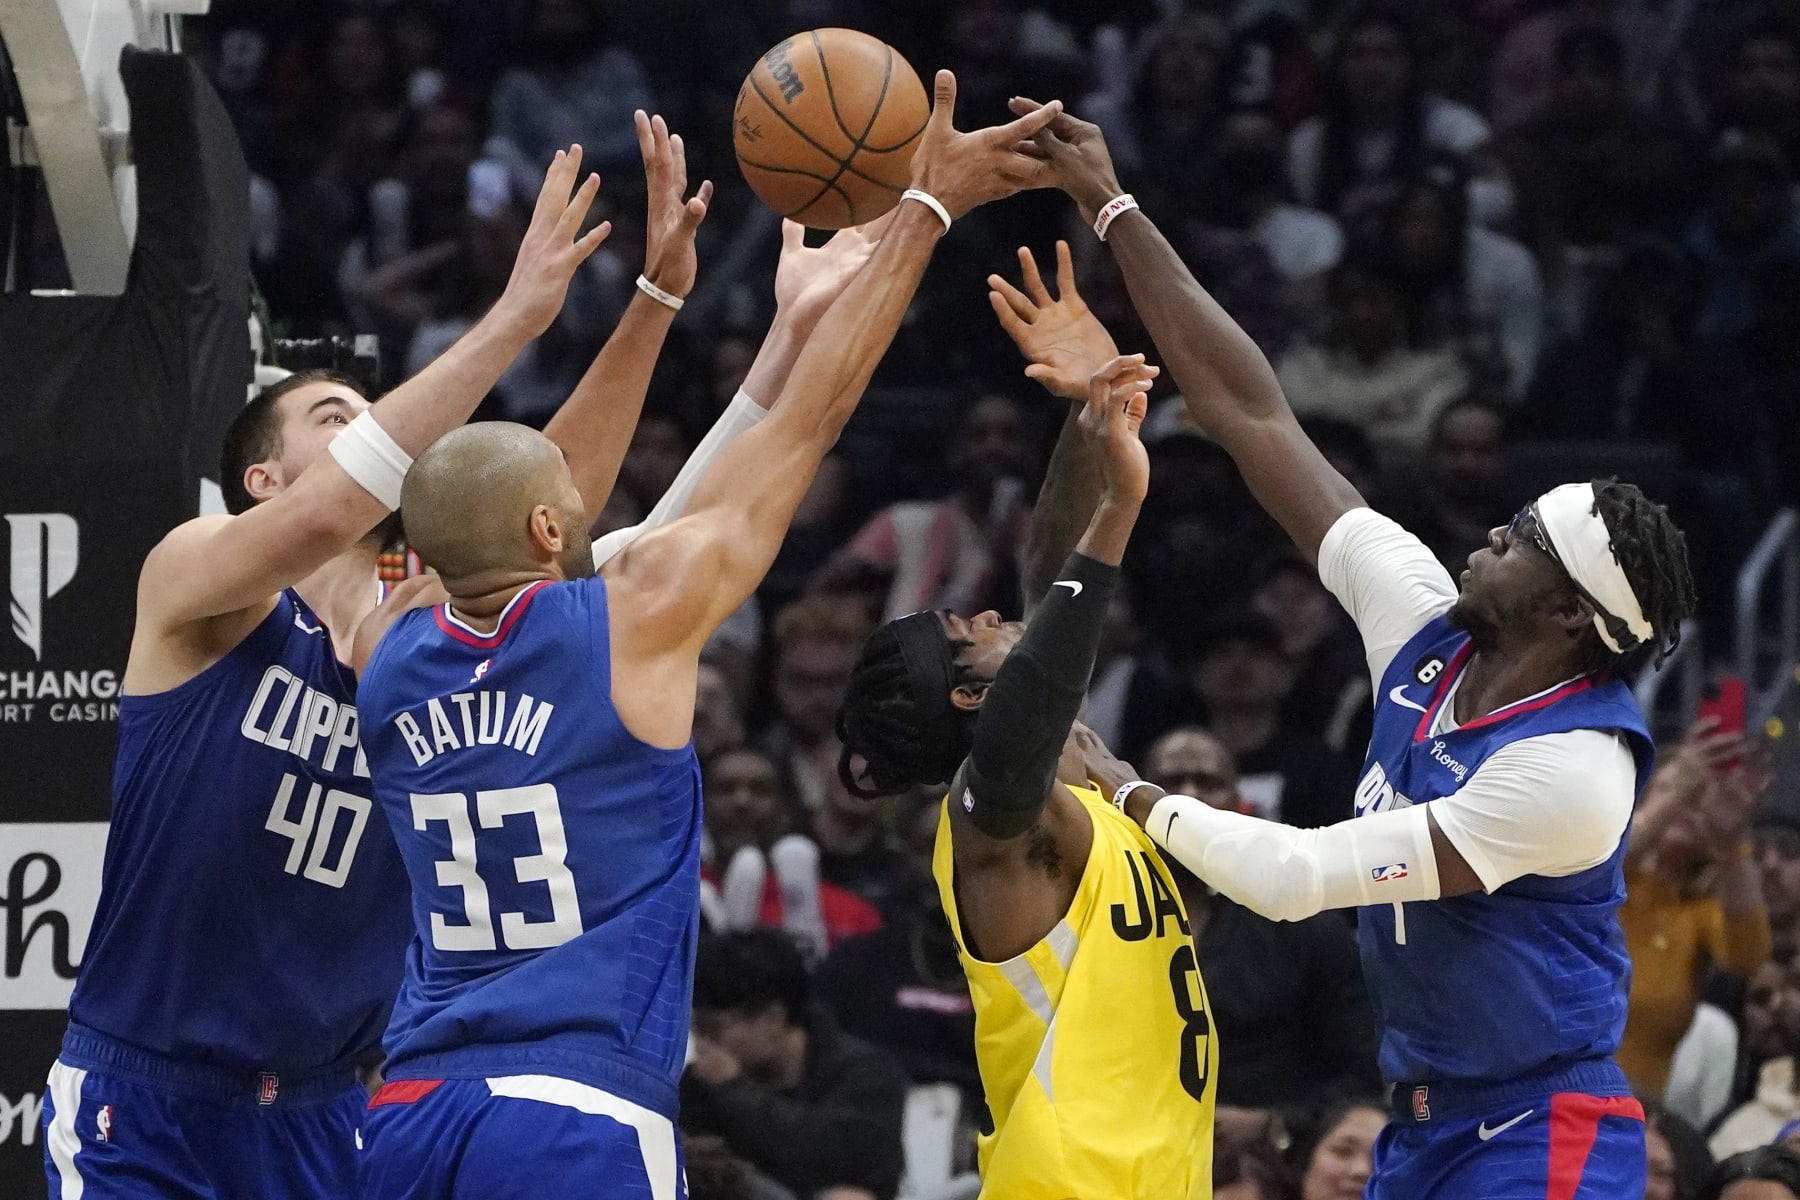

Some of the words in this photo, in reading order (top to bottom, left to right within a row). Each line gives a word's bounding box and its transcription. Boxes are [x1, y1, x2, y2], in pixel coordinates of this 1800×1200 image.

[0, 670, 125, 700] HANG
[1417, 658, 1444, 684] 6
[394, 690, 554, 767] BATUM
[1430, 740, 1469, 782] honey
[265, 773, 373, 889] 40
[410, 783, 584, 951] 33
[1110, 850, 1192, 942] JA
[1169, 945, 1209, 1104] 8
